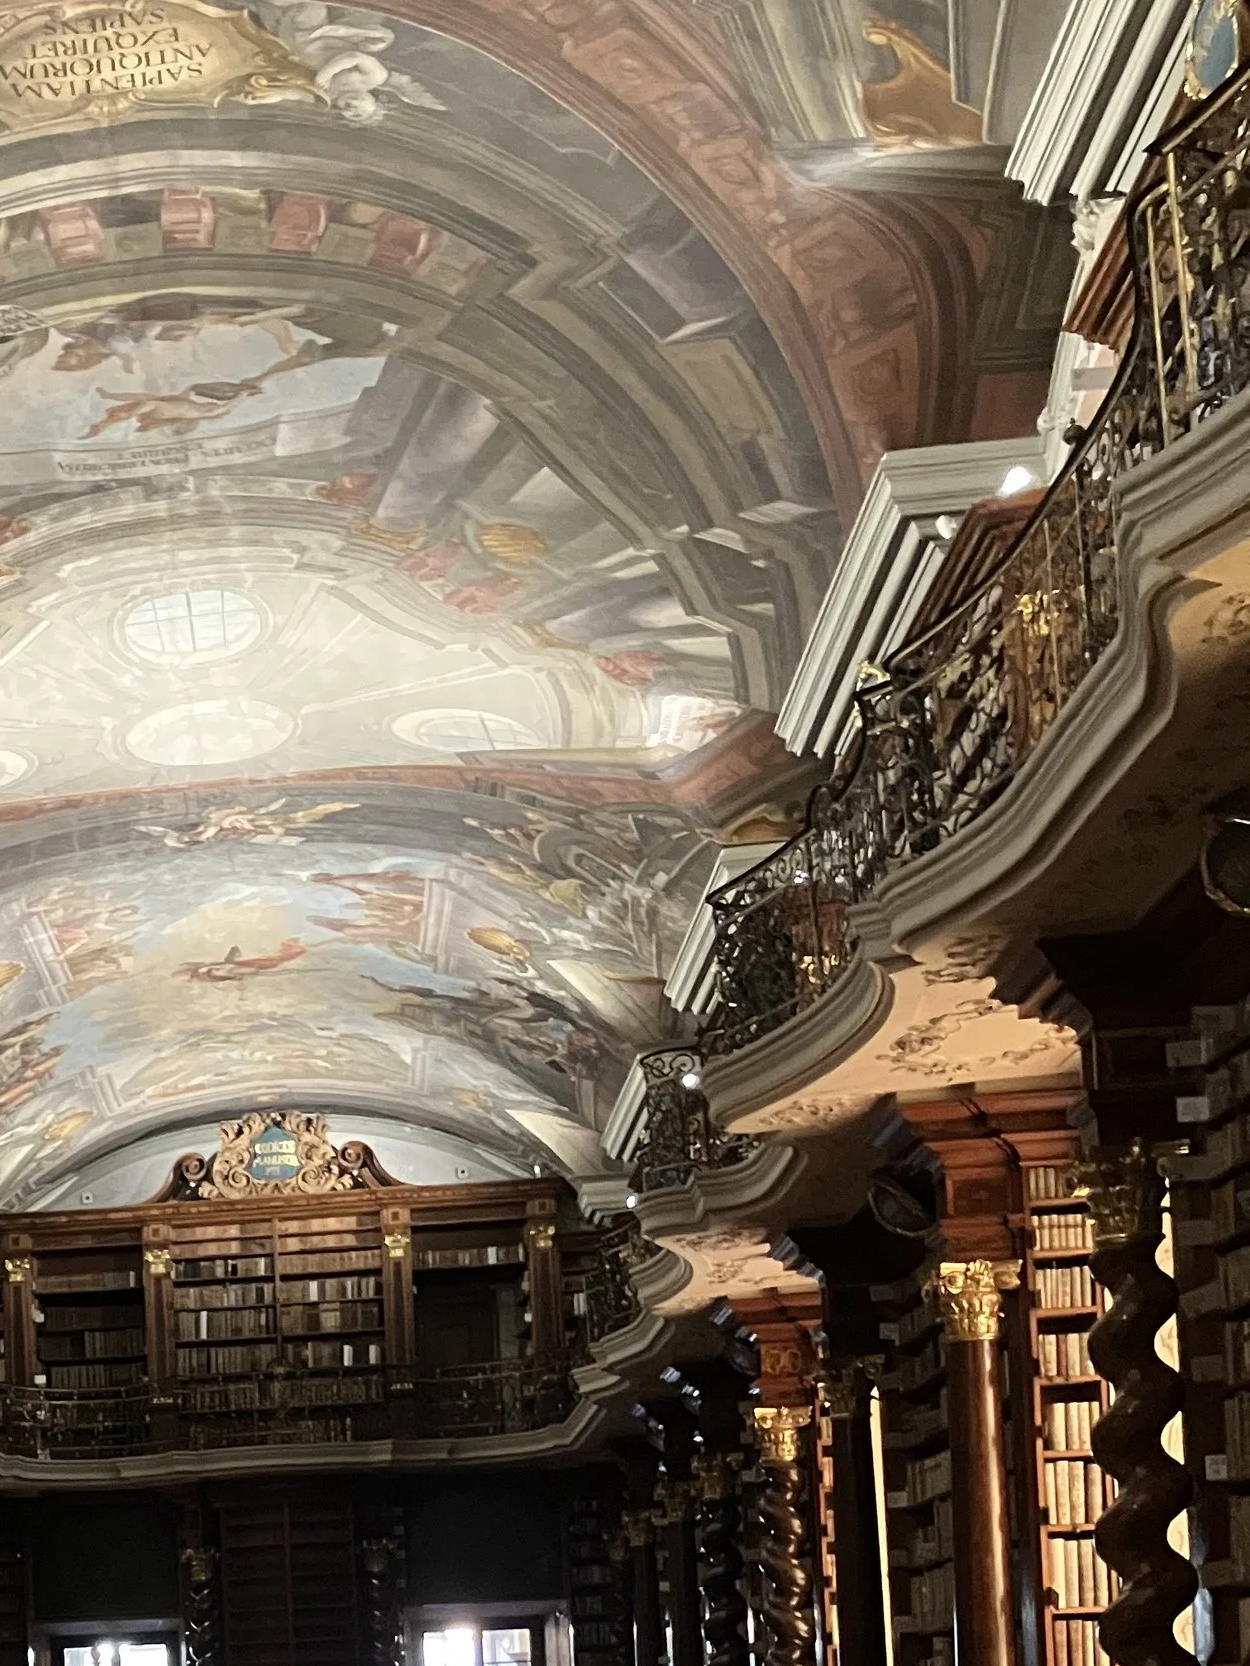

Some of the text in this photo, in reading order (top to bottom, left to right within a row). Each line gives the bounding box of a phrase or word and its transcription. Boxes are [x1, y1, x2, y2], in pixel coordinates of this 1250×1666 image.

[44, 7, 165, 36] SAPIENS
[23, 26, 180, 60] EXQUIRET
[9, 61, 204, 99] SAPIENTIAM
